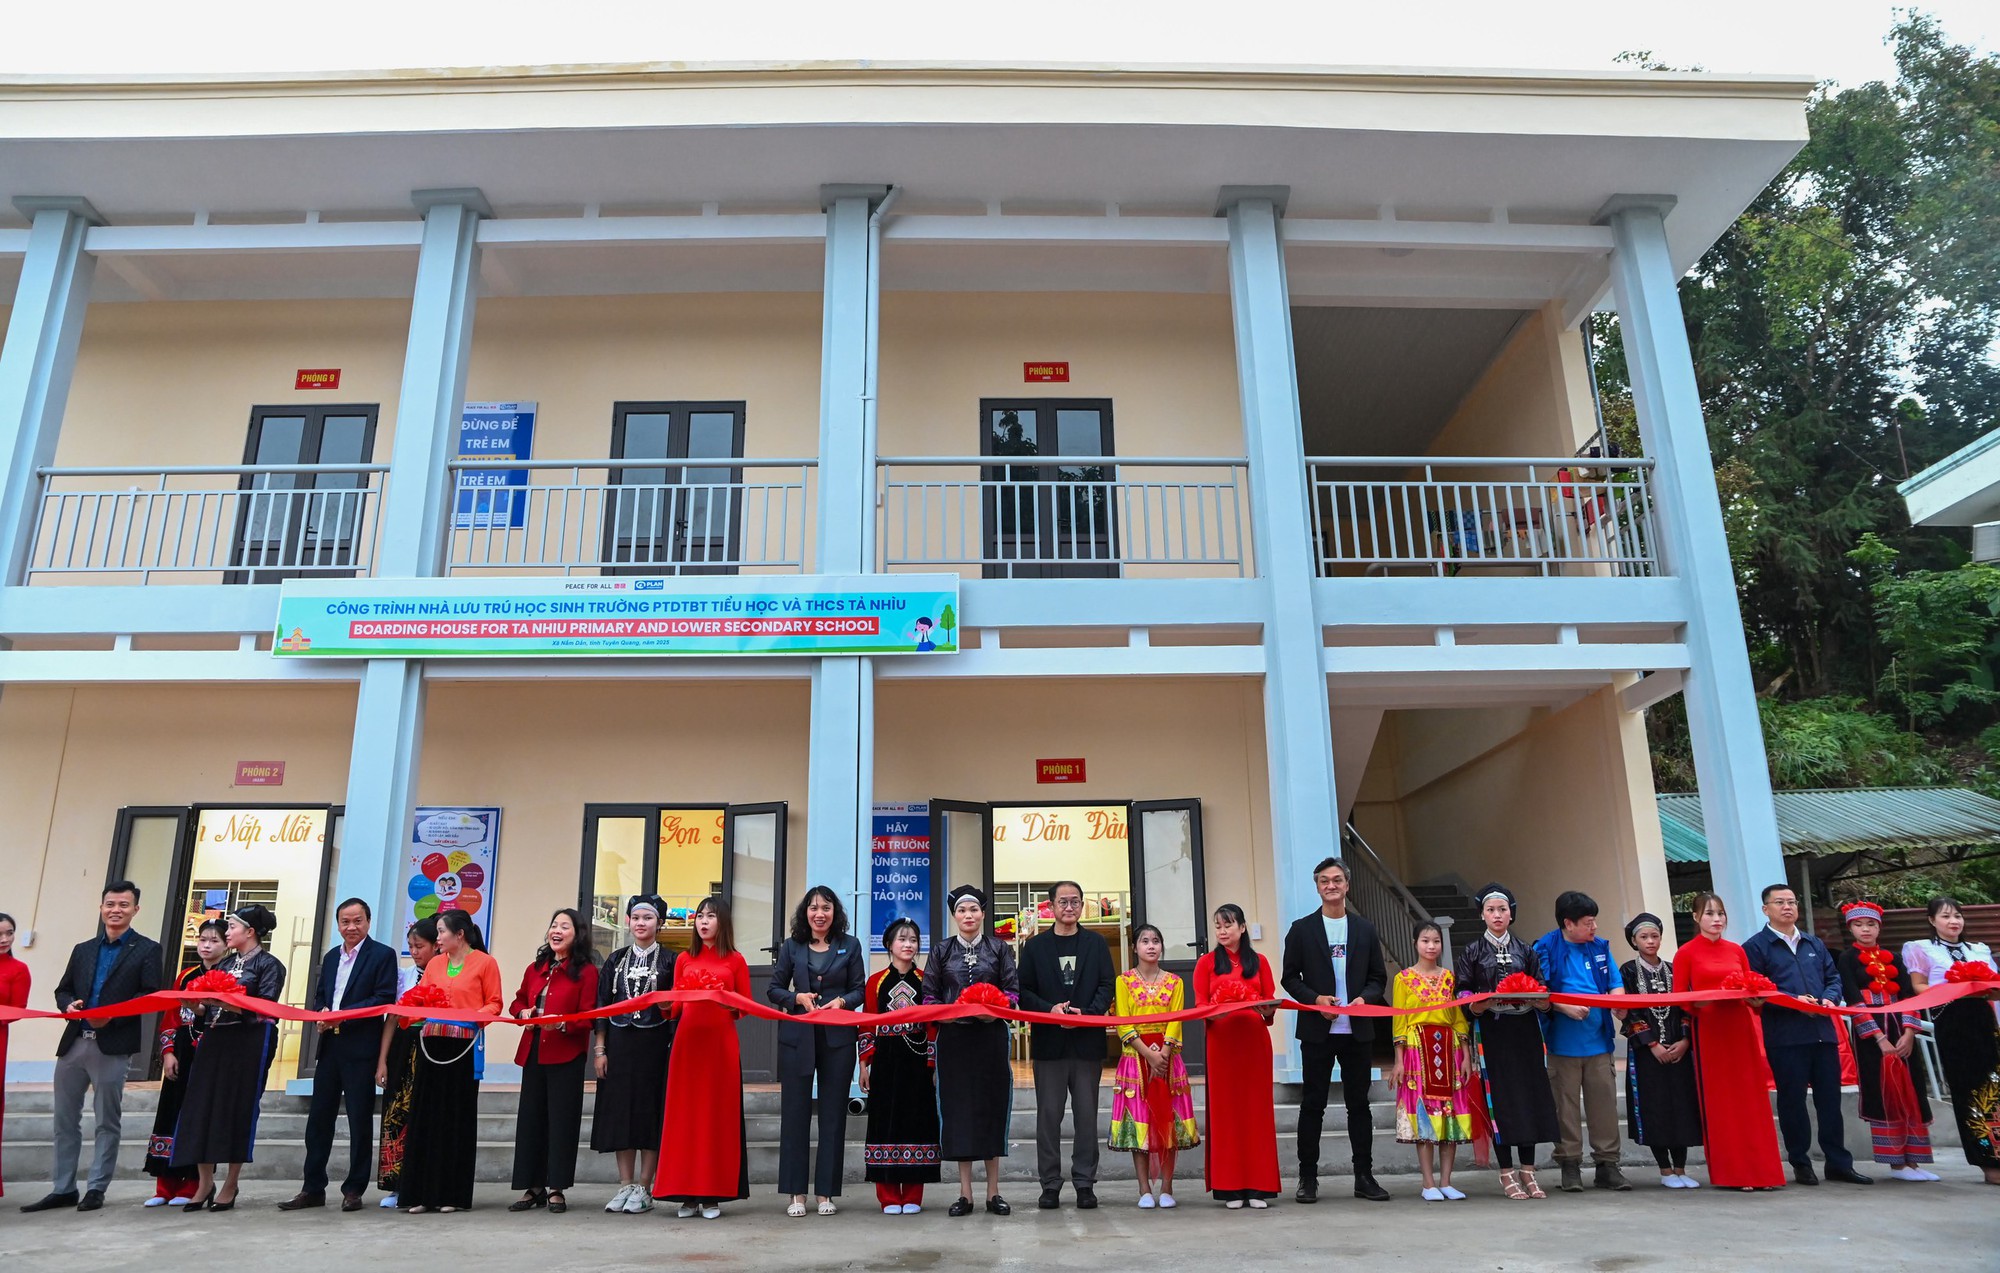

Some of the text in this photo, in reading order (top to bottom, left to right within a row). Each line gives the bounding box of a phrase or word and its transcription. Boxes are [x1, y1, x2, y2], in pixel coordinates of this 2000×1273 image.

[1029, 365, 1064, 375] PHÒNG 10
[301, 373, 335, 382] PHÒNG 9
[461, 415, 519, 431] ĐỪNG ĐỂ
[465, 435, 510, 448] TRẺ EM
[462, 473, 506, 486] TRẺ EM
[326, 595, 906, 617] CÔNG TRÌNH NHÀ LƯU TRÚ HỌC SINH TRƯỜNG PTDTBT TIỂU HỌC VÀ THCS TẢ NHÌU
[353, 620, 875, 635] BOARDING HOUSE FOR TA NHIU PRIMARY AND LOWER SECONDARY SCHOOL
[241, 765, 279, 777] PHÒNG 2
[1043, 762, 1080, 775] PHÒNG 1
[214, 814, 262, 850] Nắp
[270, 813, 313, 843] Mỗi
[660, 815, 701, 848] Gọn
[886, 822, 909, 833] HÃY
[1021, 812, 1070, 842] Dẫn
[873, 837, 885, 849] ẾN
[901, 857, 930, 868] THEO
[876, 872, 918, 884] ĐƯỜNG
[873, 888, 923, 901] TẢO HÔN
